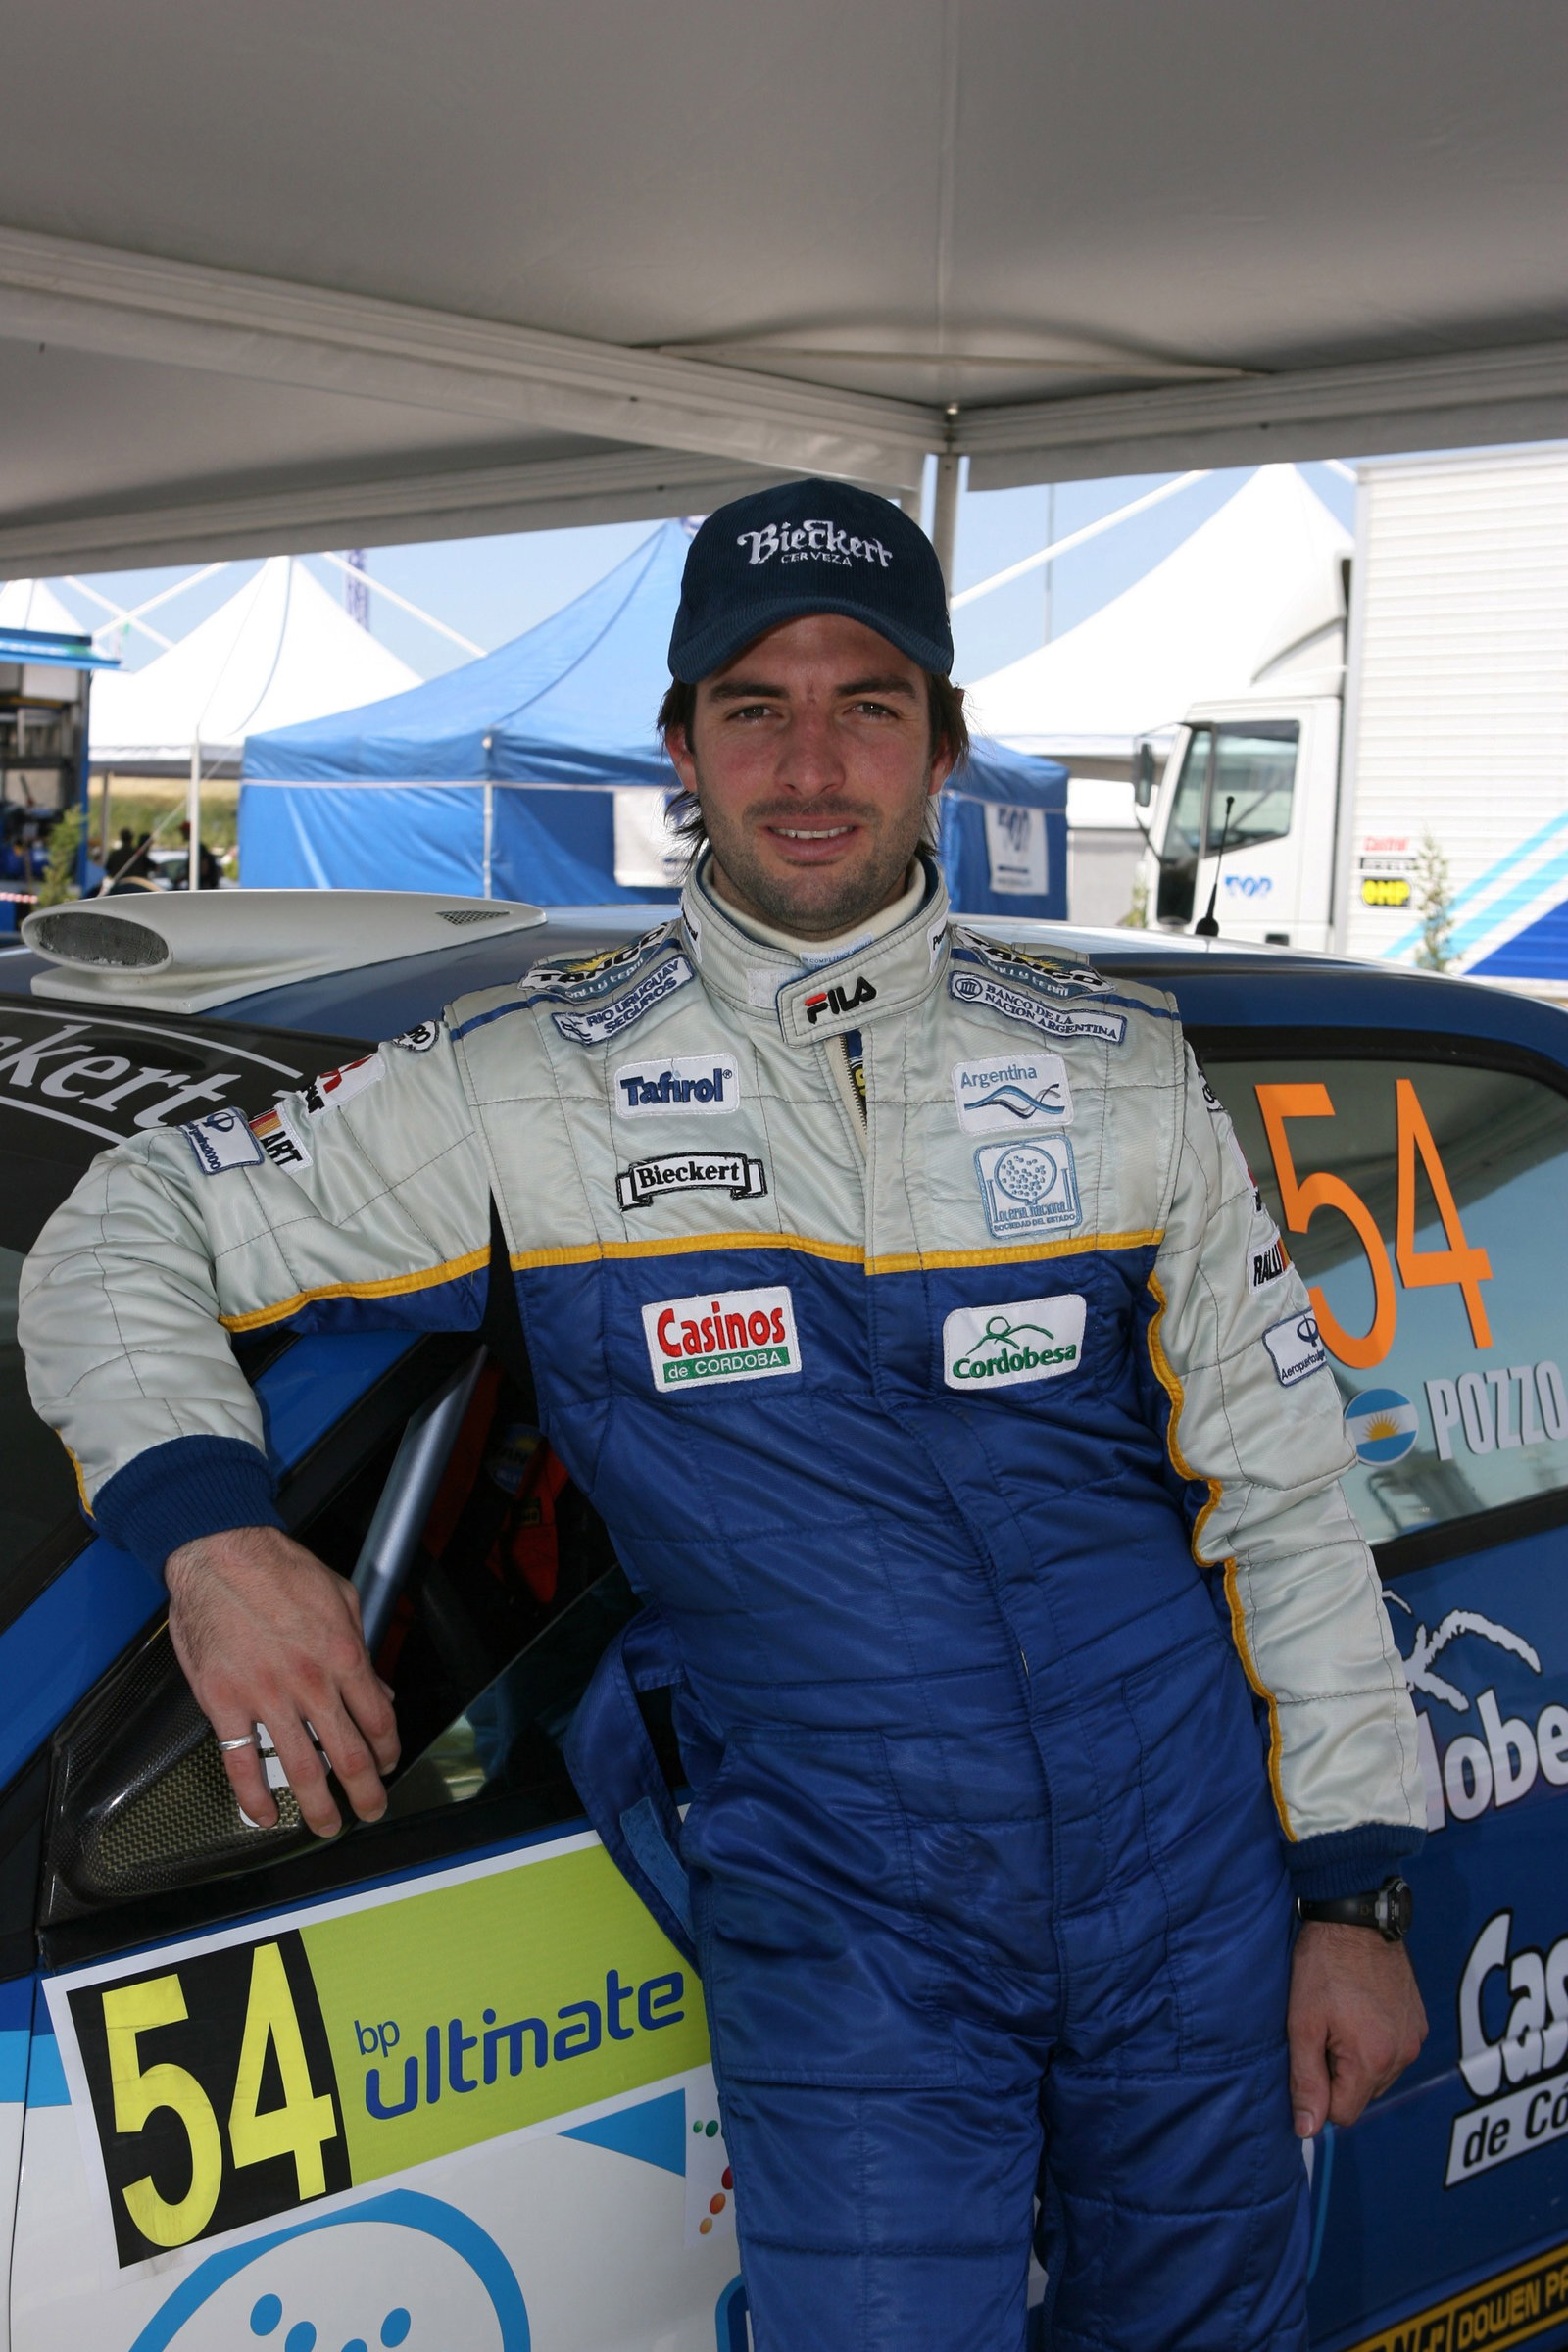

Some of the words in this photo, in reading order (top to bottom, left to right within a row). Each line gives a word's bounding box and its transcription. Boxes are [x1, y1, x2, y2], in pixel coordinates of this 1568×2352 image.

[737, 519, 893, 567] Bieckert
[781, 552, 852, 566] CERVEZA
[588, 1009, 614, 1027] RIO
[615, 961, 680, 1013] URUGUAY
[604, 977, 677, 1034] SEGUROS
[804, 976, 877, 1025] FILA
[985, 984, 1032, 1010] BANCO
[1036, 1005, 1054, 1021] DE
[1056, 1012, 1074, 1025] LA
[985, 992, 1035, 1021] NACION
[1039, 1017, 1118, 1040] ARGENTINA
[961, 1064, 1037, 1088] Argentina
[637, 1161, 740, 1188] Bieckert
[994, 1220, 1032, 1232] SOCIEDAD
[1032, 1217, 1046, 1227] DEL
[1047, 1213, 1076, 1225] ESTADO
[1255, 1079, 1493, 1369] 54
[657, 1301, 786, 1357] Casinos
[668, 1364, 688, 1380] de
[694, 1350, 782, 1374] CORDOBA
[953, 1344, 1077, 1379] Cordobesa
[1424, 1360, 1568, 1461] POZZO
[355, 2019, 401, 2057] bp
[365, 1969, 685, 2120] ultimate
[102, 1942, 338, 2248] 54
[1463, 2115, 1511, 2169] de
